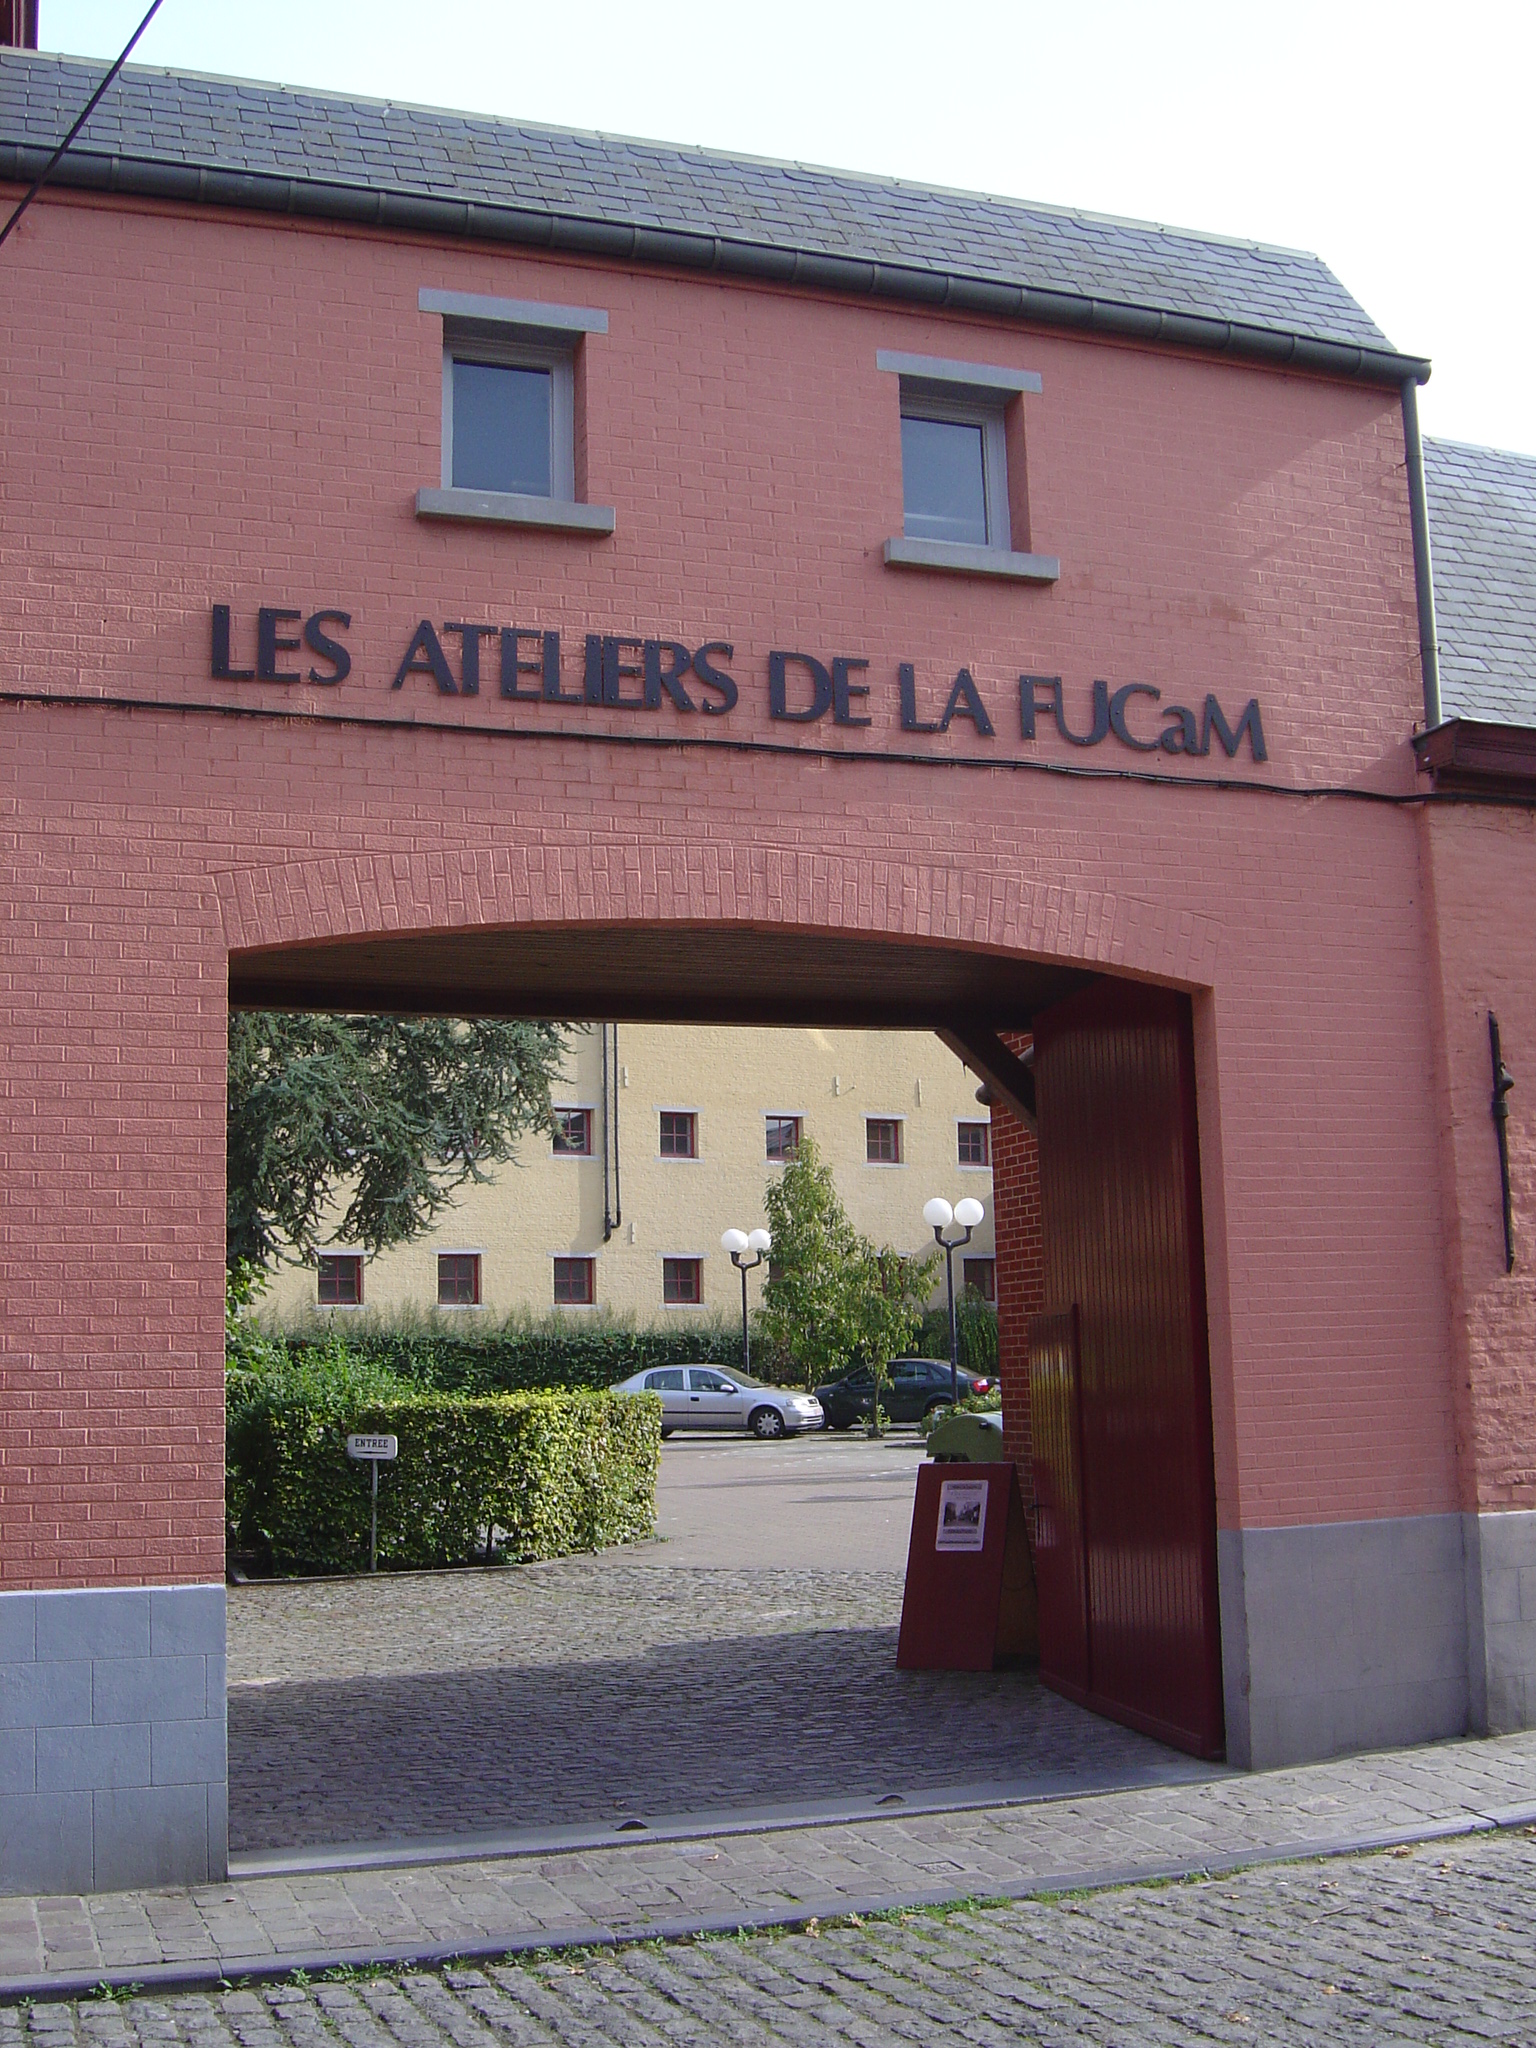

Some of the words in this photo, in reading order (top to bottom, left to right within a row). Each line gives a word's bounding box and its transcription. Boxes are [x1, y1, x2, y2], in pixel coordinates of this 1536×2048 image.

[211, 604, 351, 686] LES
[391, 619, 739, 716] ATELIERS
[769, 650, 872, 727] DE
[899, 662, 996, 737] LA
[1019, 674, 1269, 763] FUCaM
[354, 1438, 389, 1448] ENTREE
